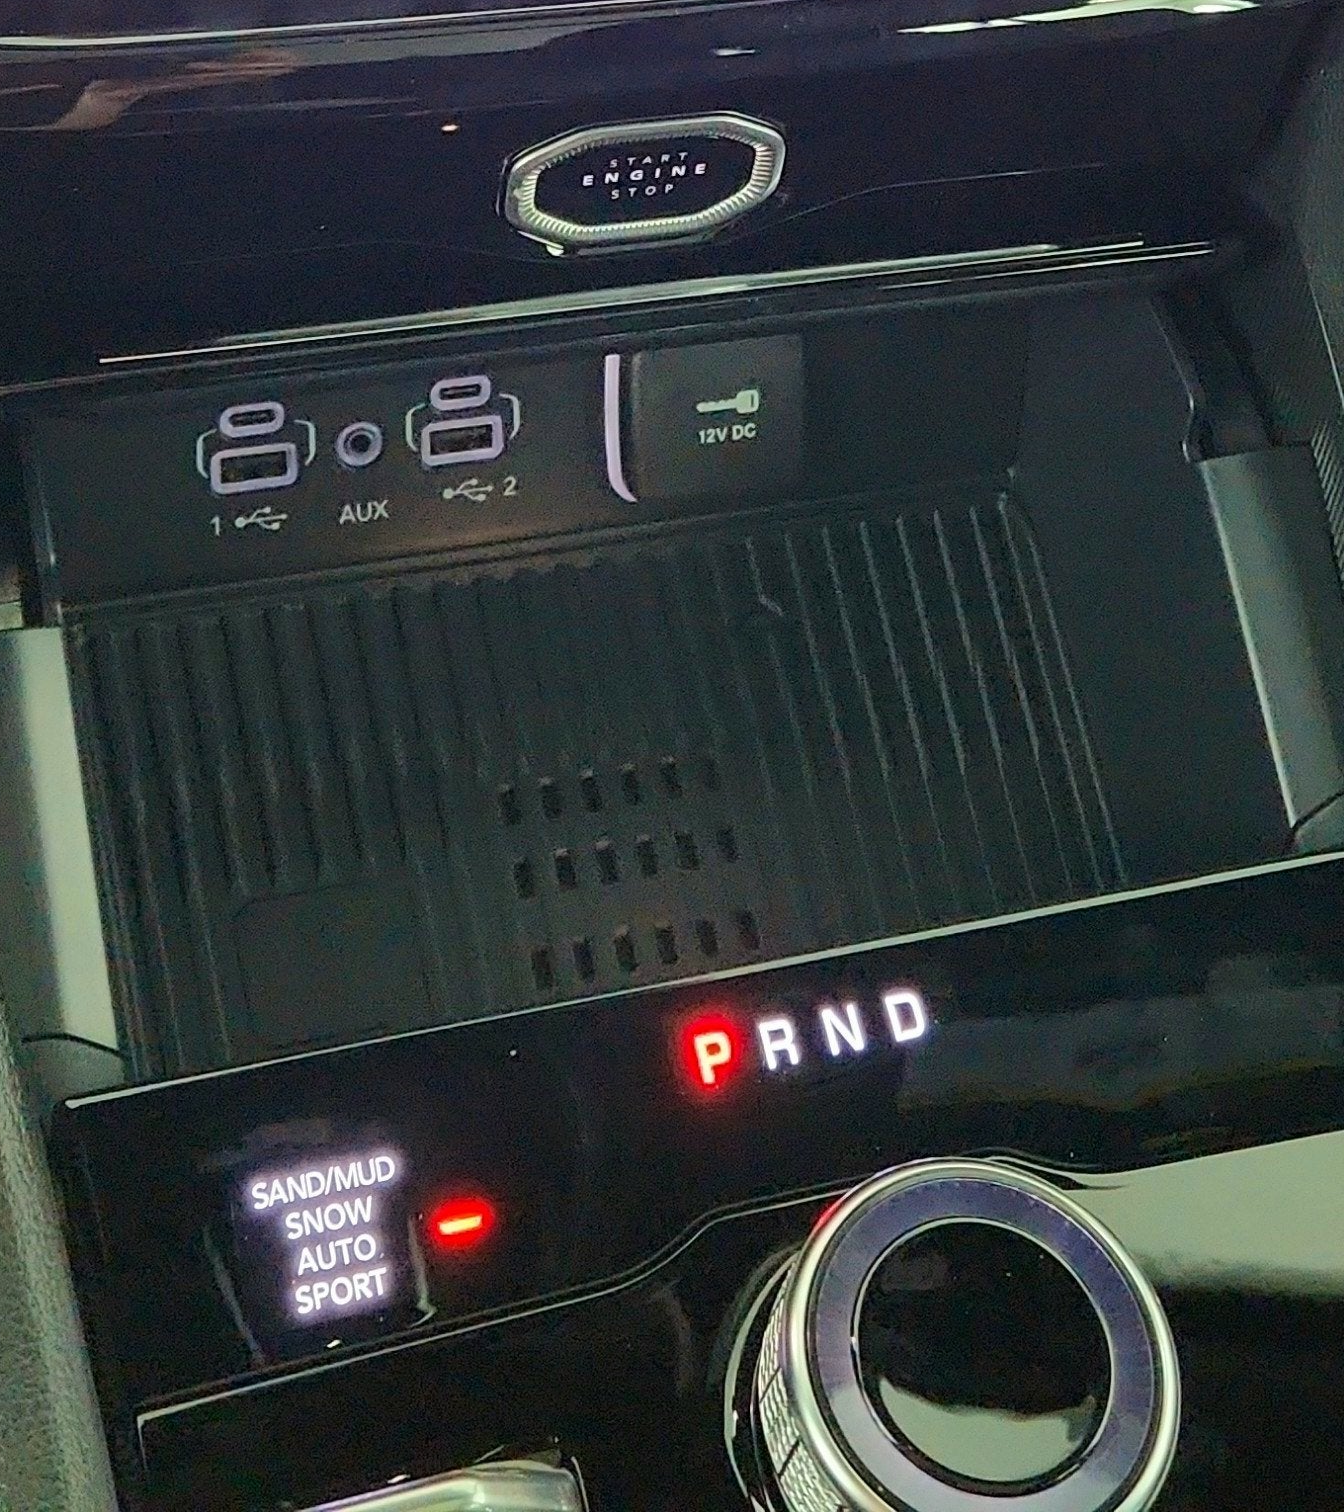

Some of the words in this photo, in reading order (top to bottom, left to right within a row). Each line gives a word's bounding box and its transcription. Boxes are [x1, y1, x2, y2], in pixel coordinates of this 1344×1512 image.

[610, 151, 688, 168] START
[582, 162, 707, 187] ENGINE
[611, 183, 674, 200] STOP
[698, 426, 728, 444] 12V
[731, 422, 757, 441] DC
[502, 475, 517, 496] 2
[339, 499, 390, 525] AUX
[210, 516, 221, 536] 1
[693, 1029, 731, 1085] P
[759, 1019, 799, 1070] R
[822, 1003, 865, 1056] N
[885, 991, 926, 1042] D
[251, 1155, 396, 1211] SAND/MUD
[284, 1196, 375, 1241] SNOW
[296, 1234, 376, 1278] AUTO
[294, 1267, 387, 1316] SPORT
